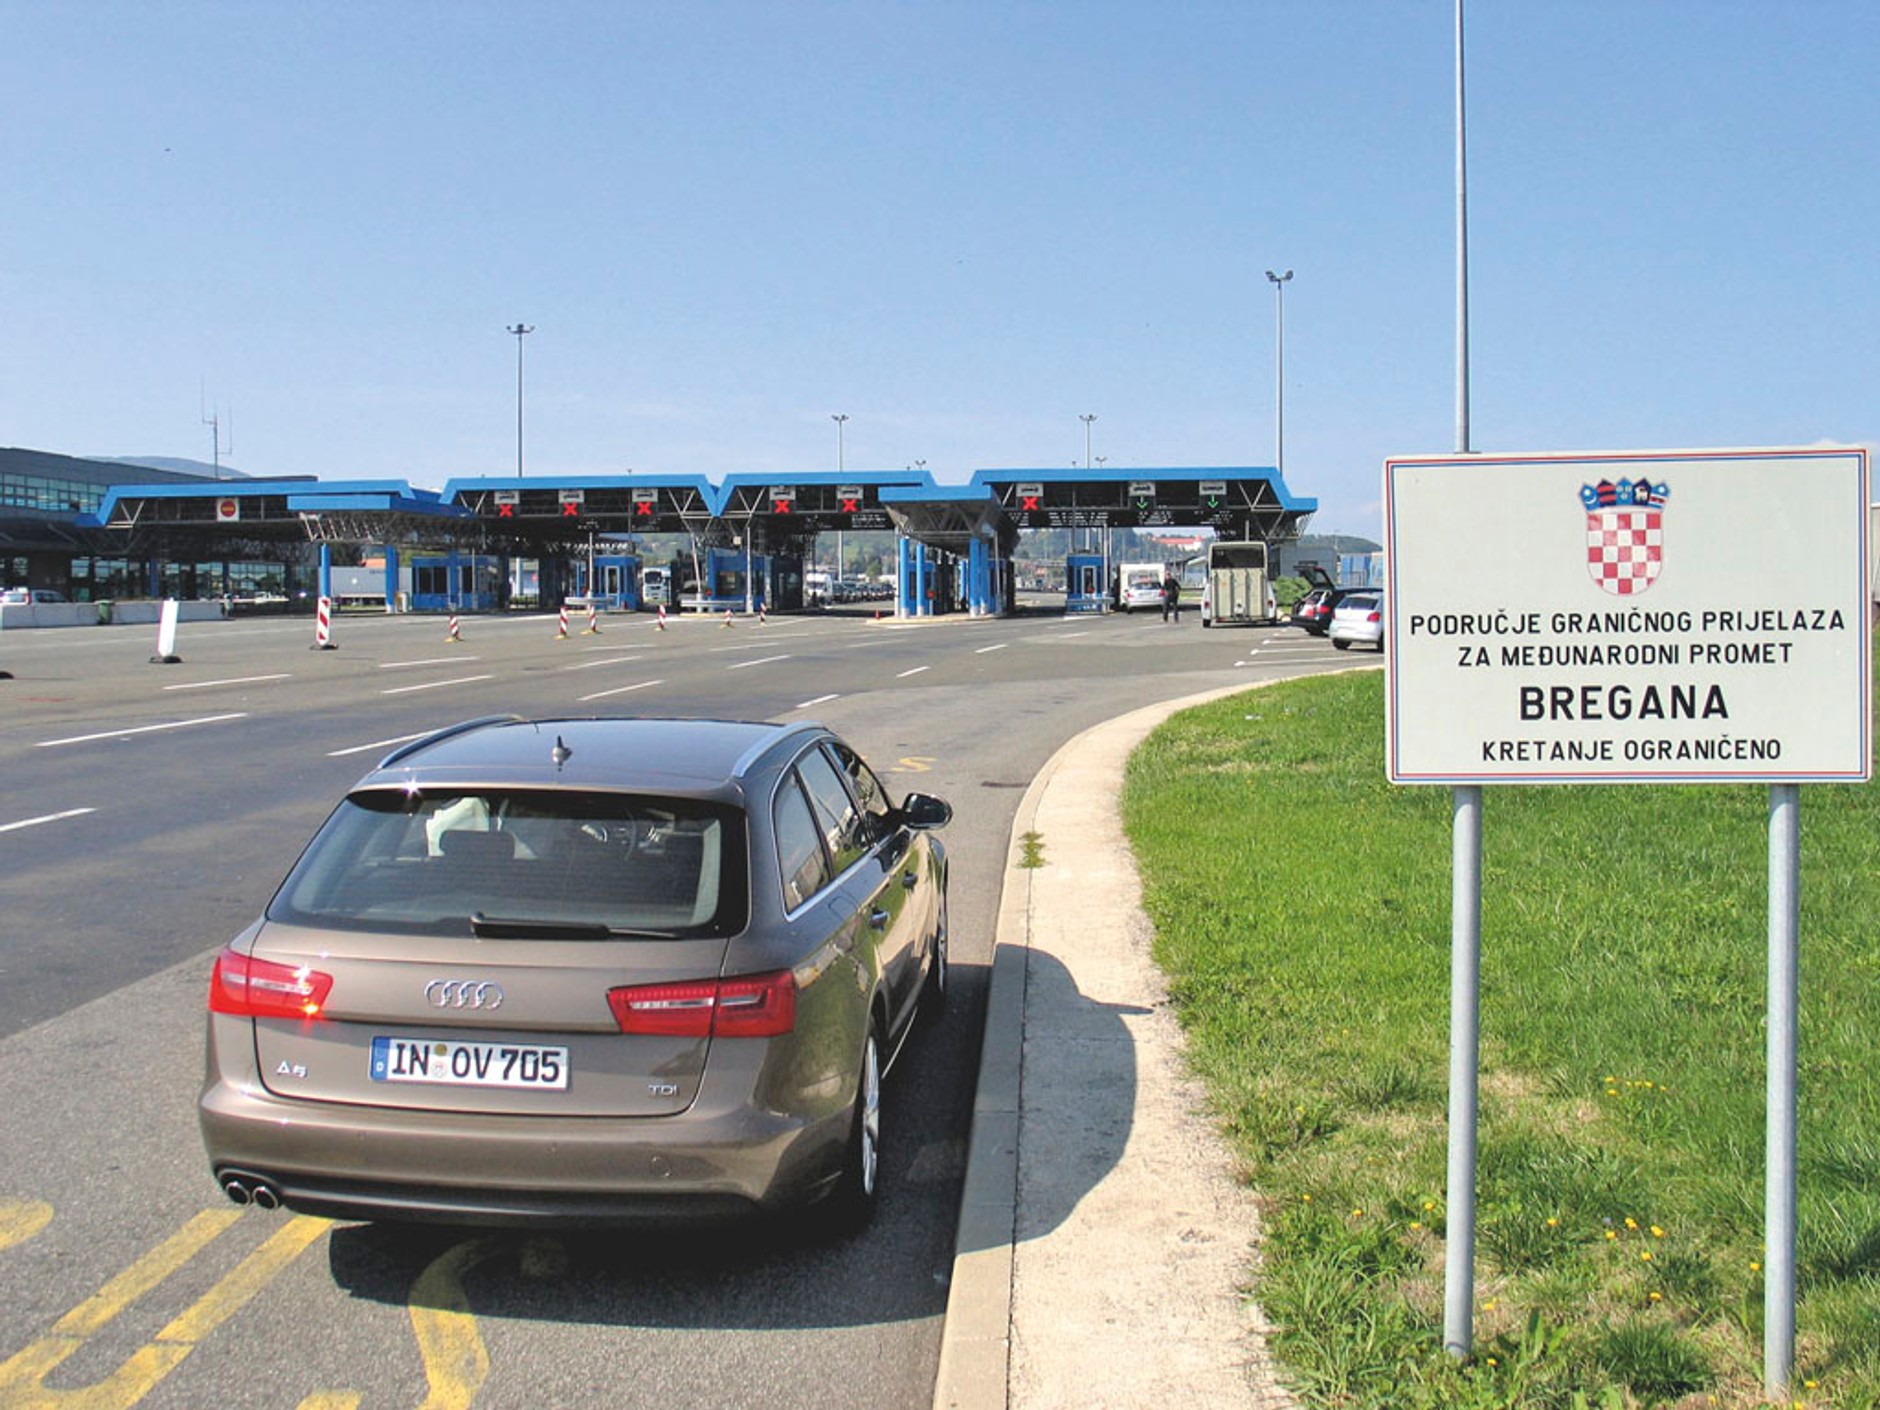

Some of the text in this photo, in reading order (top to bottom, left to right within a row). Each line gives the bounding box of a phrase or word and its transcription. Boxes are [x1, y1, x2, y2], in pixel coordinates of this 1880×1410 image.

[1411, 608, 1845, 635] PODRUČJE GRANIČNOG PRIJELAZA
[1459, 643, 1793, 666] ZA MEĐUNARODNI PROMET
[1521, 685, 1729, 720] BREGANA
[1483, 735, 1781, 760] KRETANJE OGRANIČENO
[393, 1044, 562, 1083] IN OV 705
[648, 1084, 677, 1096] TDI
